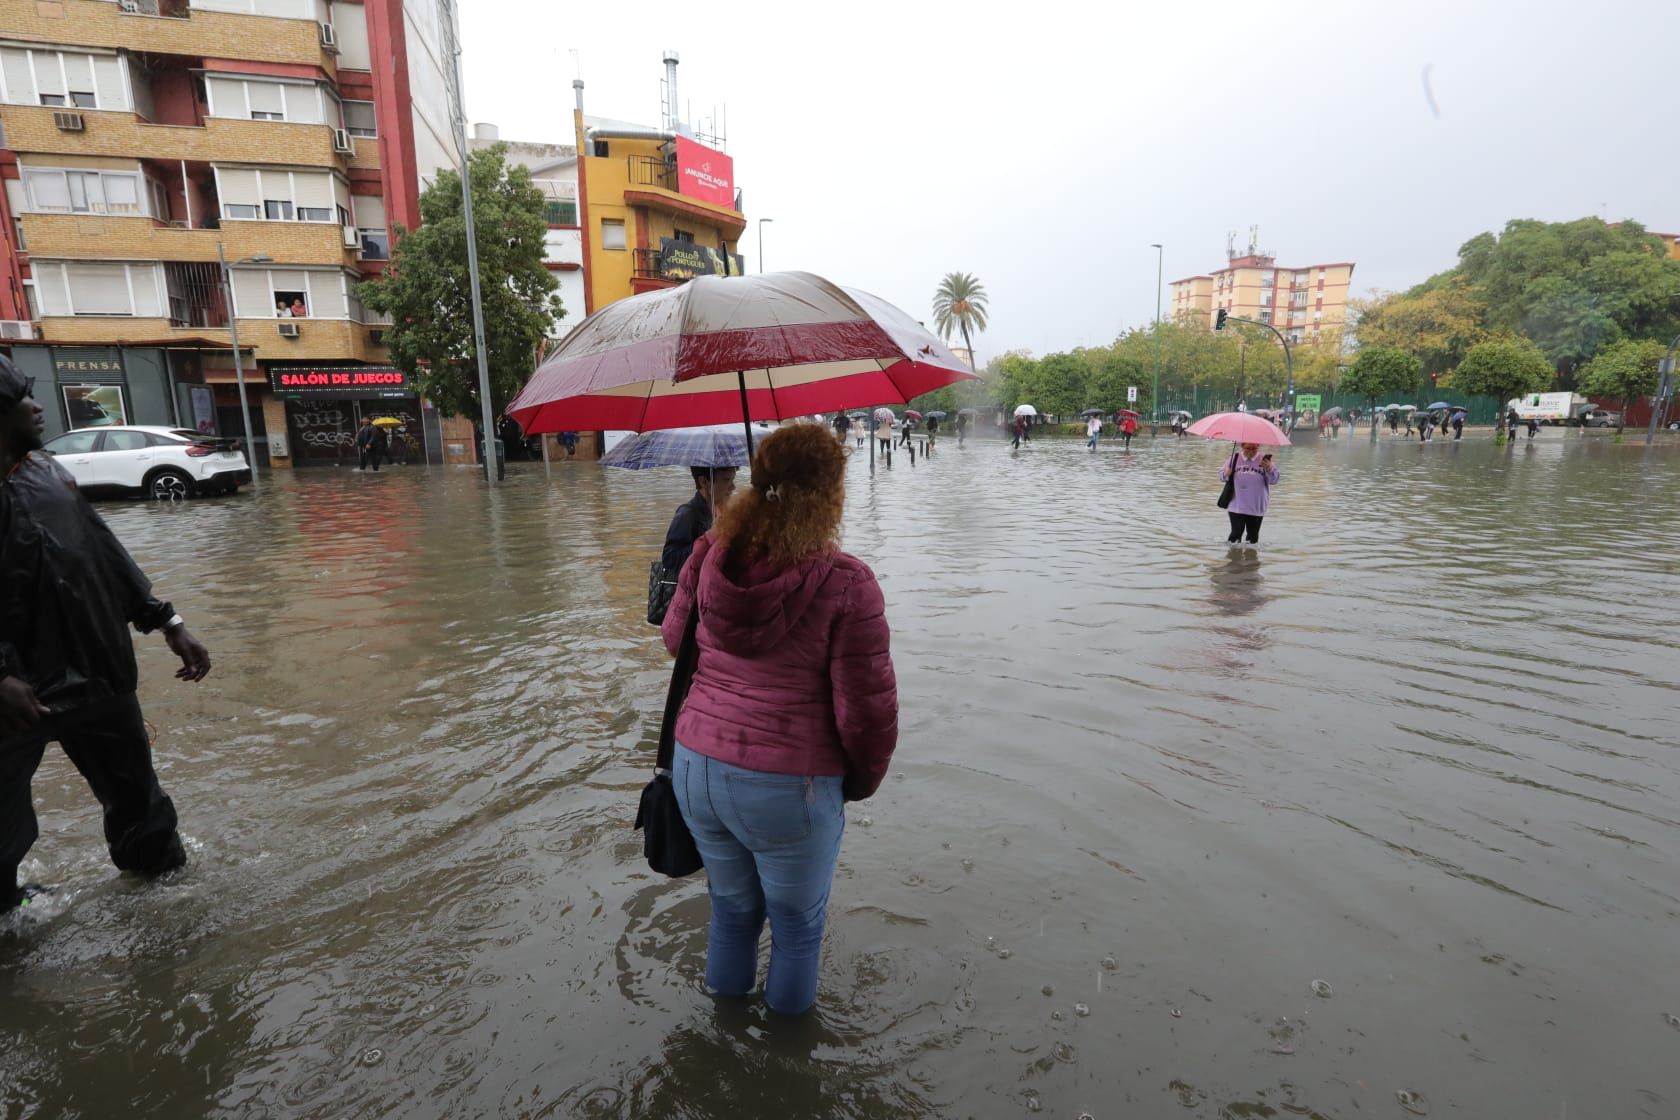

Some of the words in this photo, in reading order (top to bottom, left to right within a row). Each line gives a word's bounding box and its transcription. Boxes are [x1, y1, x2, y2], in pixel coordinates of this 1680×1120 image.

[56, 361, 121, 370] PRENSA
[281, 371, 329, 385] SALÓN
[332, 373, 350, 384] DE
[352, 373, 403, 384] JUEGOS
